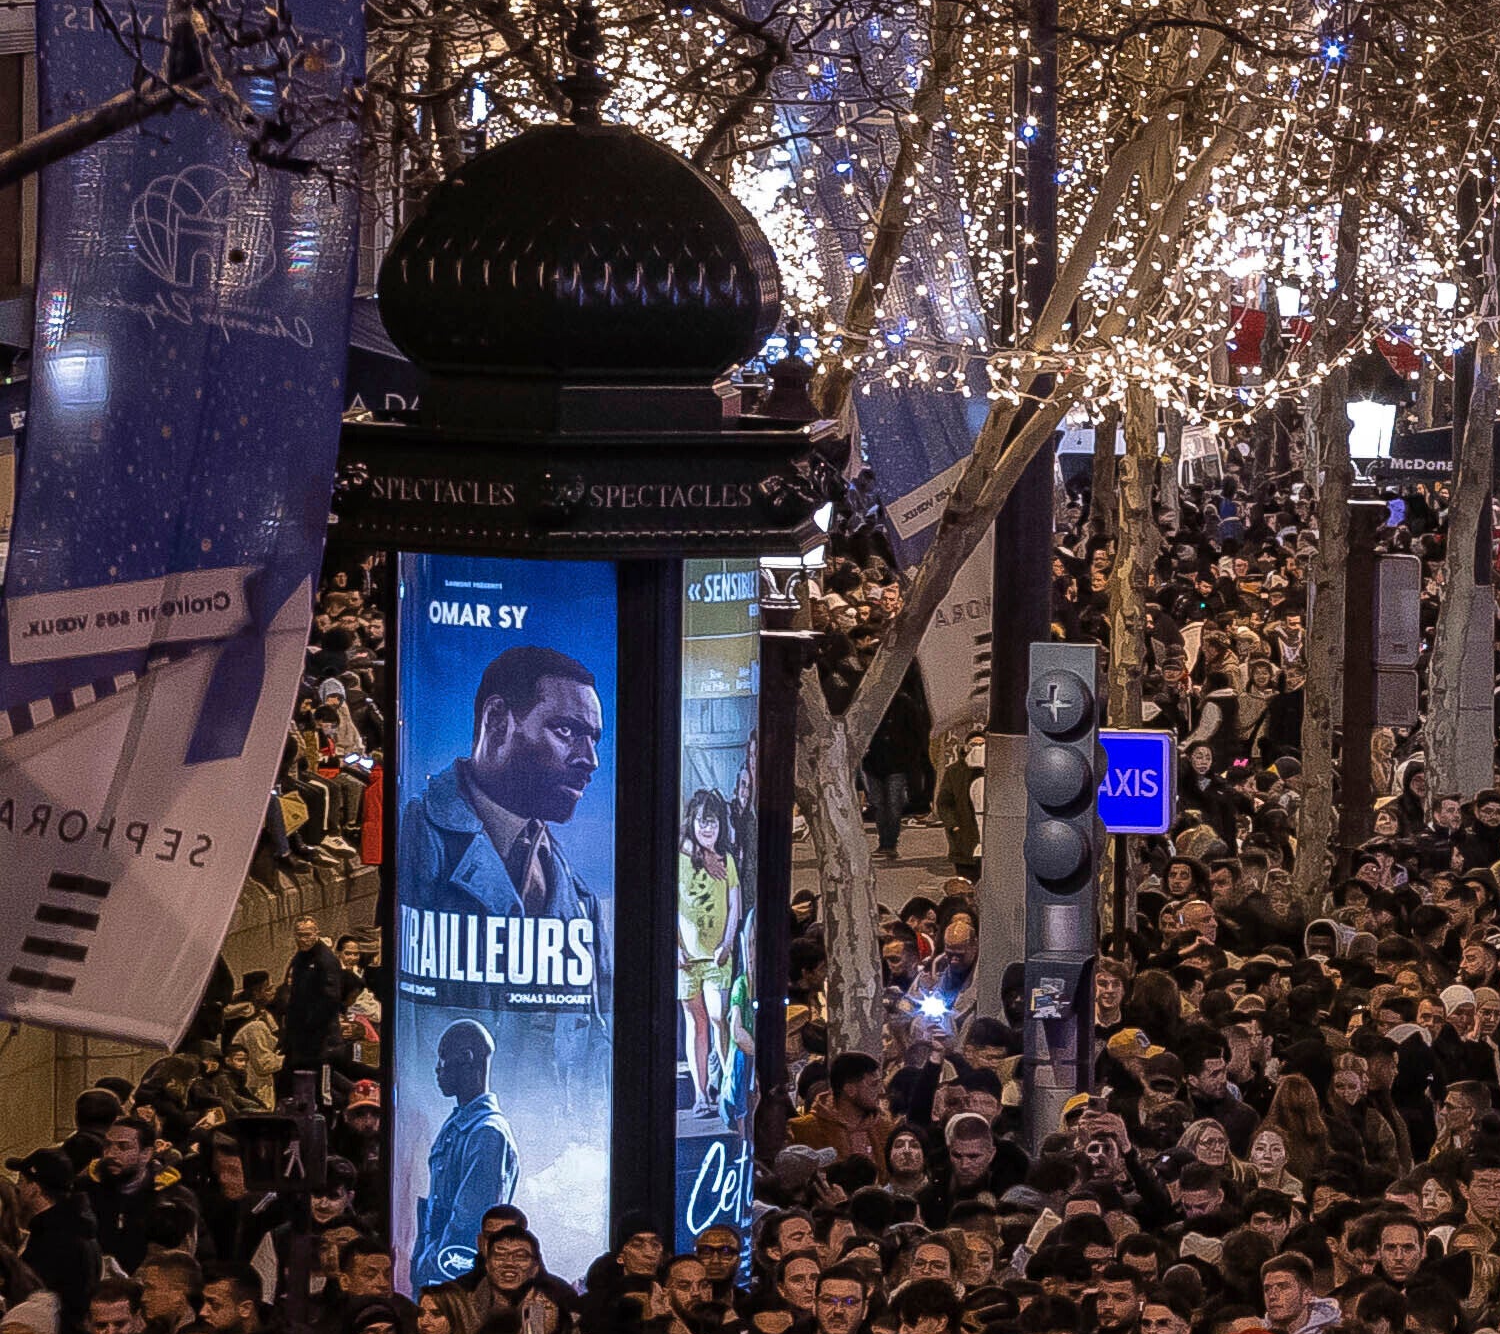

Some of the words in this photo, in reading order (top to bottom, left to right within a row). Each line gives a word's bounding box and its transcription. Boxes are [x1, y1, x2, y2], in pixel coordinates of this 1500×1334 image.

[1390, 458, 1453, 471] McDona
[371, 476, 515, 506] SPECTACLES
[589, 485, 752, 508] SPECTACLES
[704, 570, 760, 603] SENSIBL
[429, 600, 493, 628] OMAR
[498, 605, 529, 630] SY
[1098, 768, 1159, 798] AXIS
[509, 993, 543, 1004] JONAS
[545, 993, 592, 1005] BLOQUET
